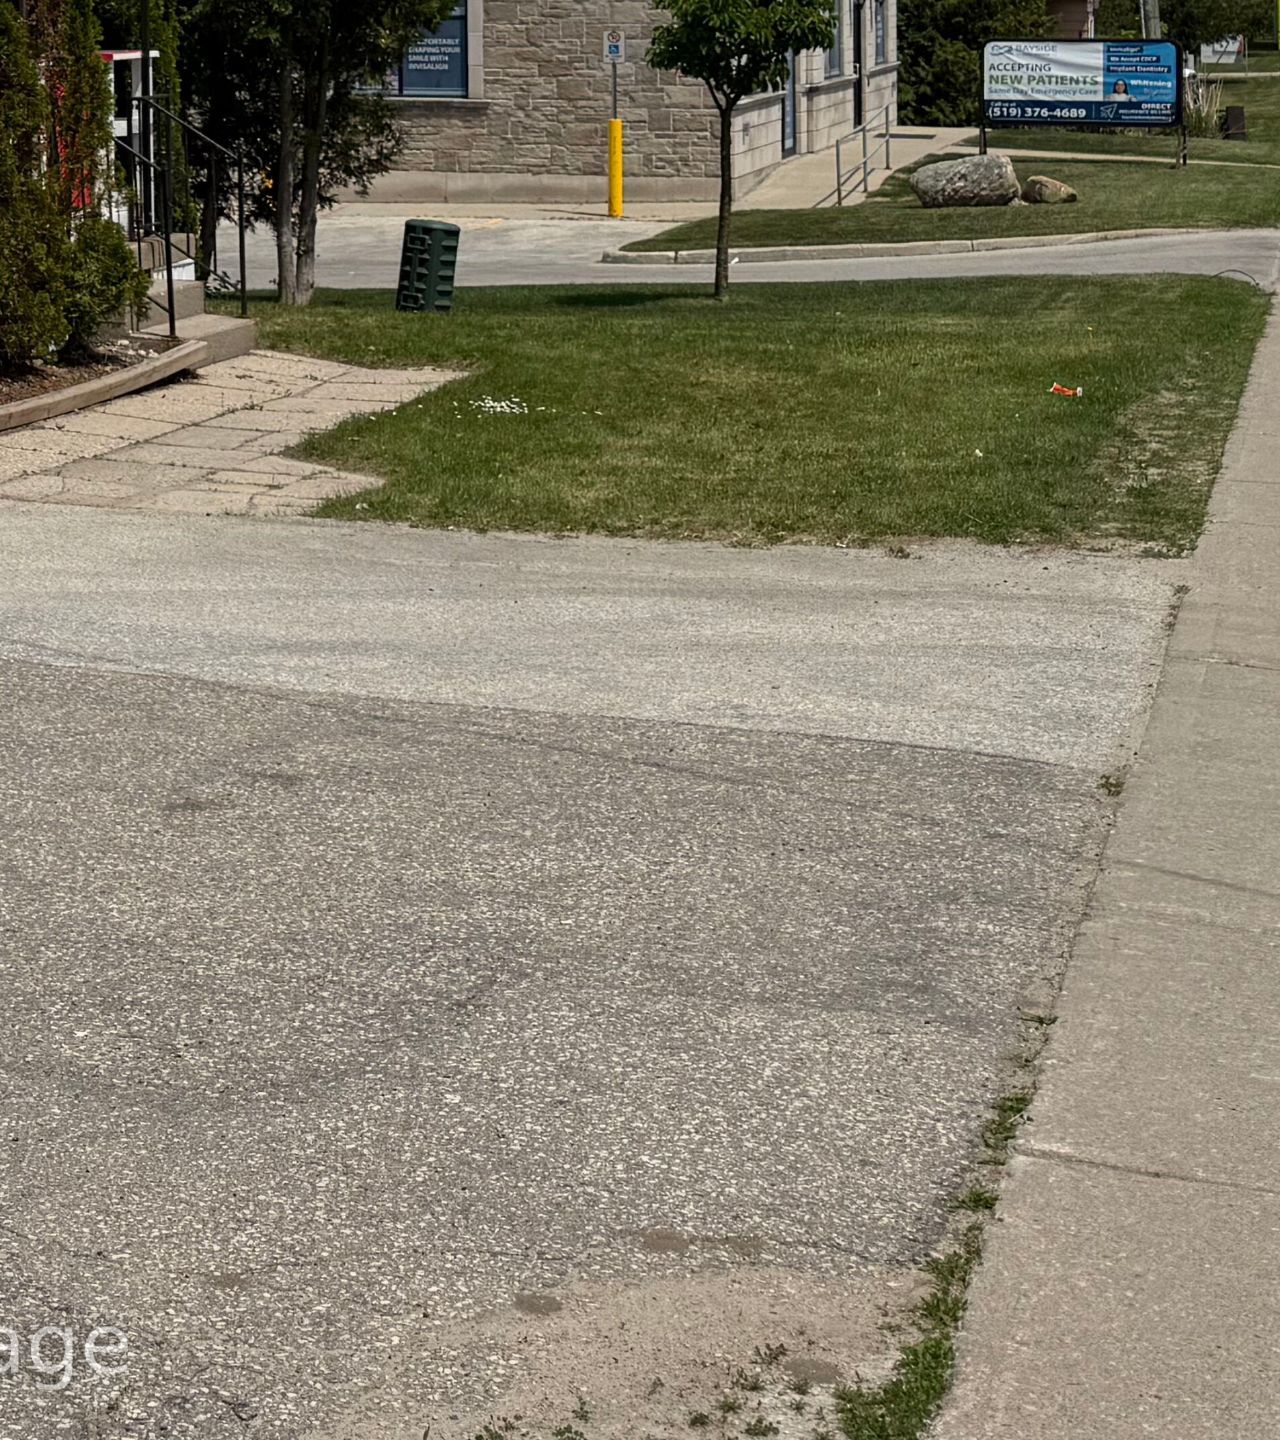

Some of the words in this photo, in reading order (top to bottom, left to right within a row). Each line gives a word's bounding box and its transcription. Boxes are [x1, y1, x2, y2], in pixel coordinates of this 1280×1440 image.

[989, 62, 1052, 73] ACCEPTING
[989, 74, 1024, 85] NEW
[1027, 74, 1100, 86] PATIENTS
[1130, 79, 1172, 89] Whitening
[989, 87, 1011, 95] Same
[1031, 87, 1077, 96] Emergency
[1078, 88, 1099, 96] Care
[988, 107, 1022, 119] (519)
[1024, 107, 1087, 118] 376-4689
